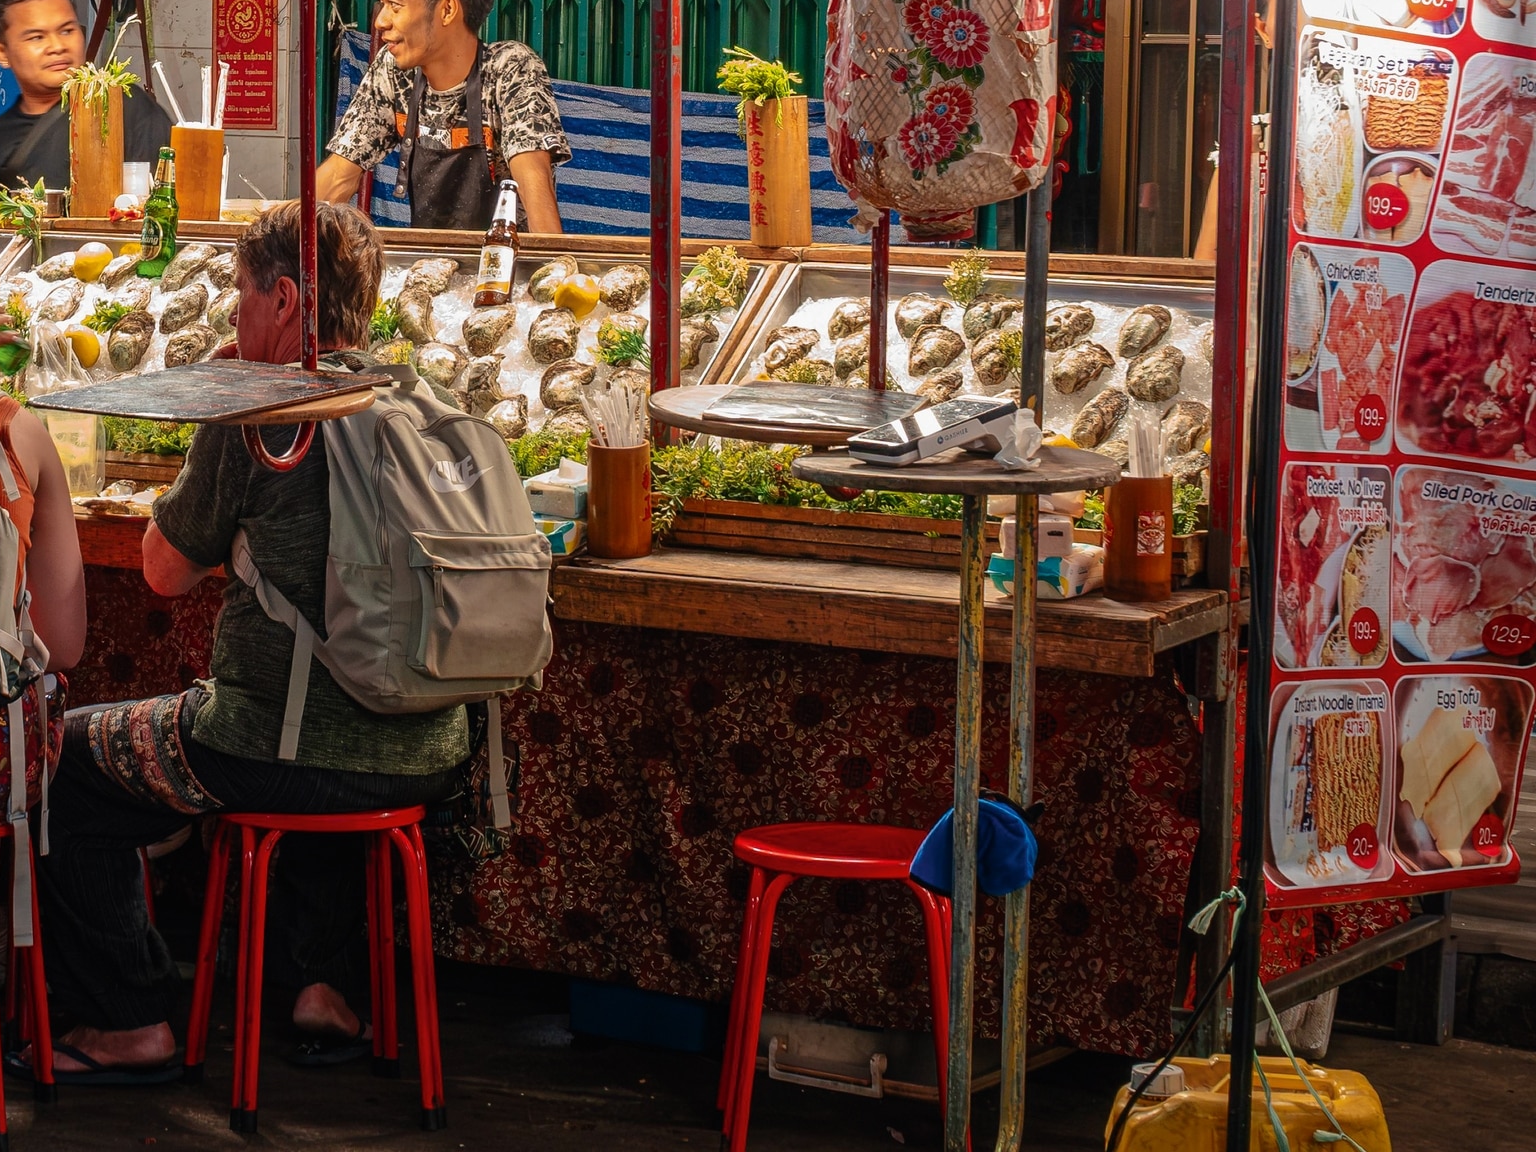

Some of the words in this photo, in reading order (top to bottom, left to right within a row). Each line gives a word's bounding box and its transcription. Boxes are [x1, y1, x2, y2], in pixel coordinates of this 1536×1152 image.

[1376, 54, 1405, 73] Set
[1368, 195, 1402, 217] 199.-
[1326, 263, 1365, 282] Chicken
[1358, 407, 1385, 426] 199.-
[1308, 478, 1326, 495] Pork
[1348, 480, 1362, 496] No
[1364, 480, 1384, 496] liver
[1461, 487, 1498, 507] Pork
[1352, 621, 1377, 640] 199.-
[1491, 624, 1530, 645] 129.-
[1319, 695, 1354, 711] Noodle
[1356, 695, 1385, 711] (mama)
[1438, 690, 1455, 709] Egg
[1457, 688, 1479, 705] Tofu
[1478, 827, 1498, 846] 20.-
[1352, 837, 1374, 856] 20.-
